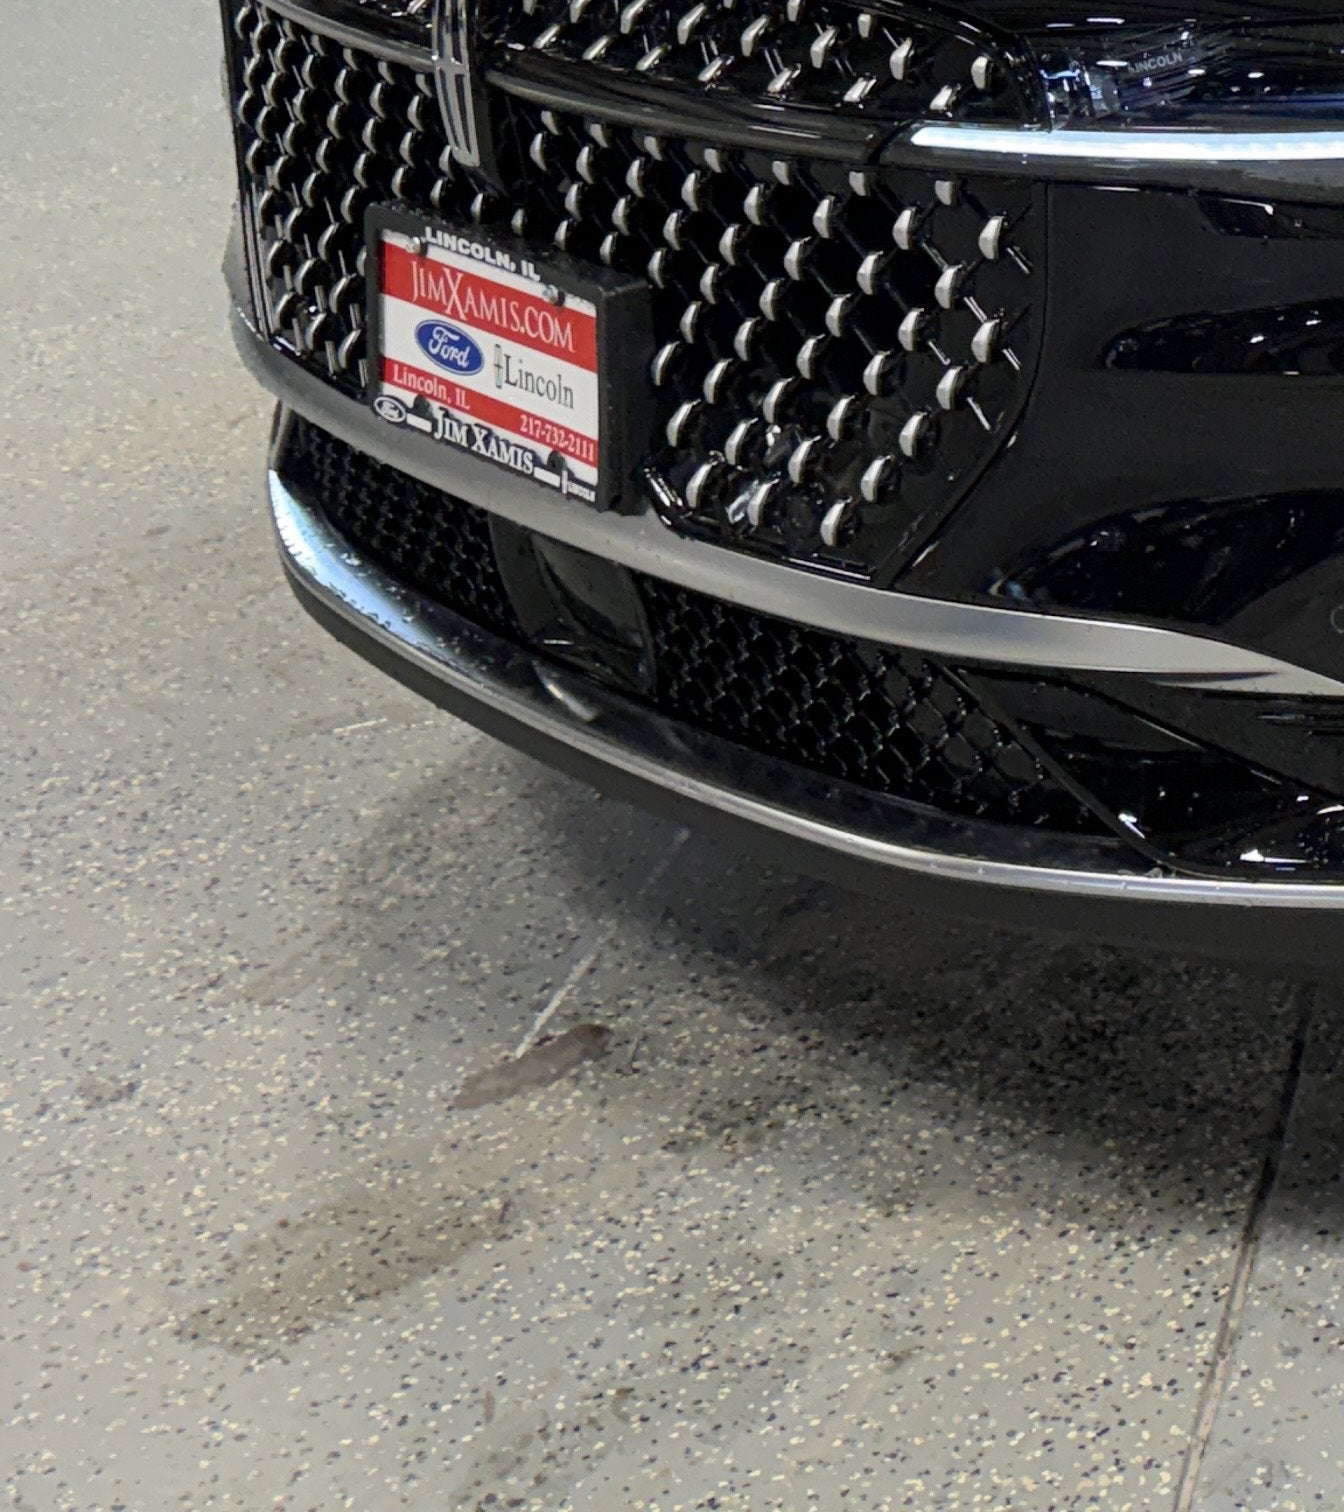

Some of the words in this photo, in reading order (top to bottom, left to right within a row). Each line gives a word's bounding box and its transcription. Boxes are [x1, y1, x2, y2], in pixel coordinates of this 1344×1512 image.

[424, 225, 517, 273] LINCOLN,
[521, 259, 541, 282] IL
[428, 325, 470, 369] Ford
[393, 363, 452, 405] Lincoln,
[455, 388, 471, 411] IL
[503, 353, 576, 410] Lincoln
[433, 406, 469, 448] JIM
[471, 424, 534, 475] XAMIS
[520, 413, 595, 462] 217-732-2111
